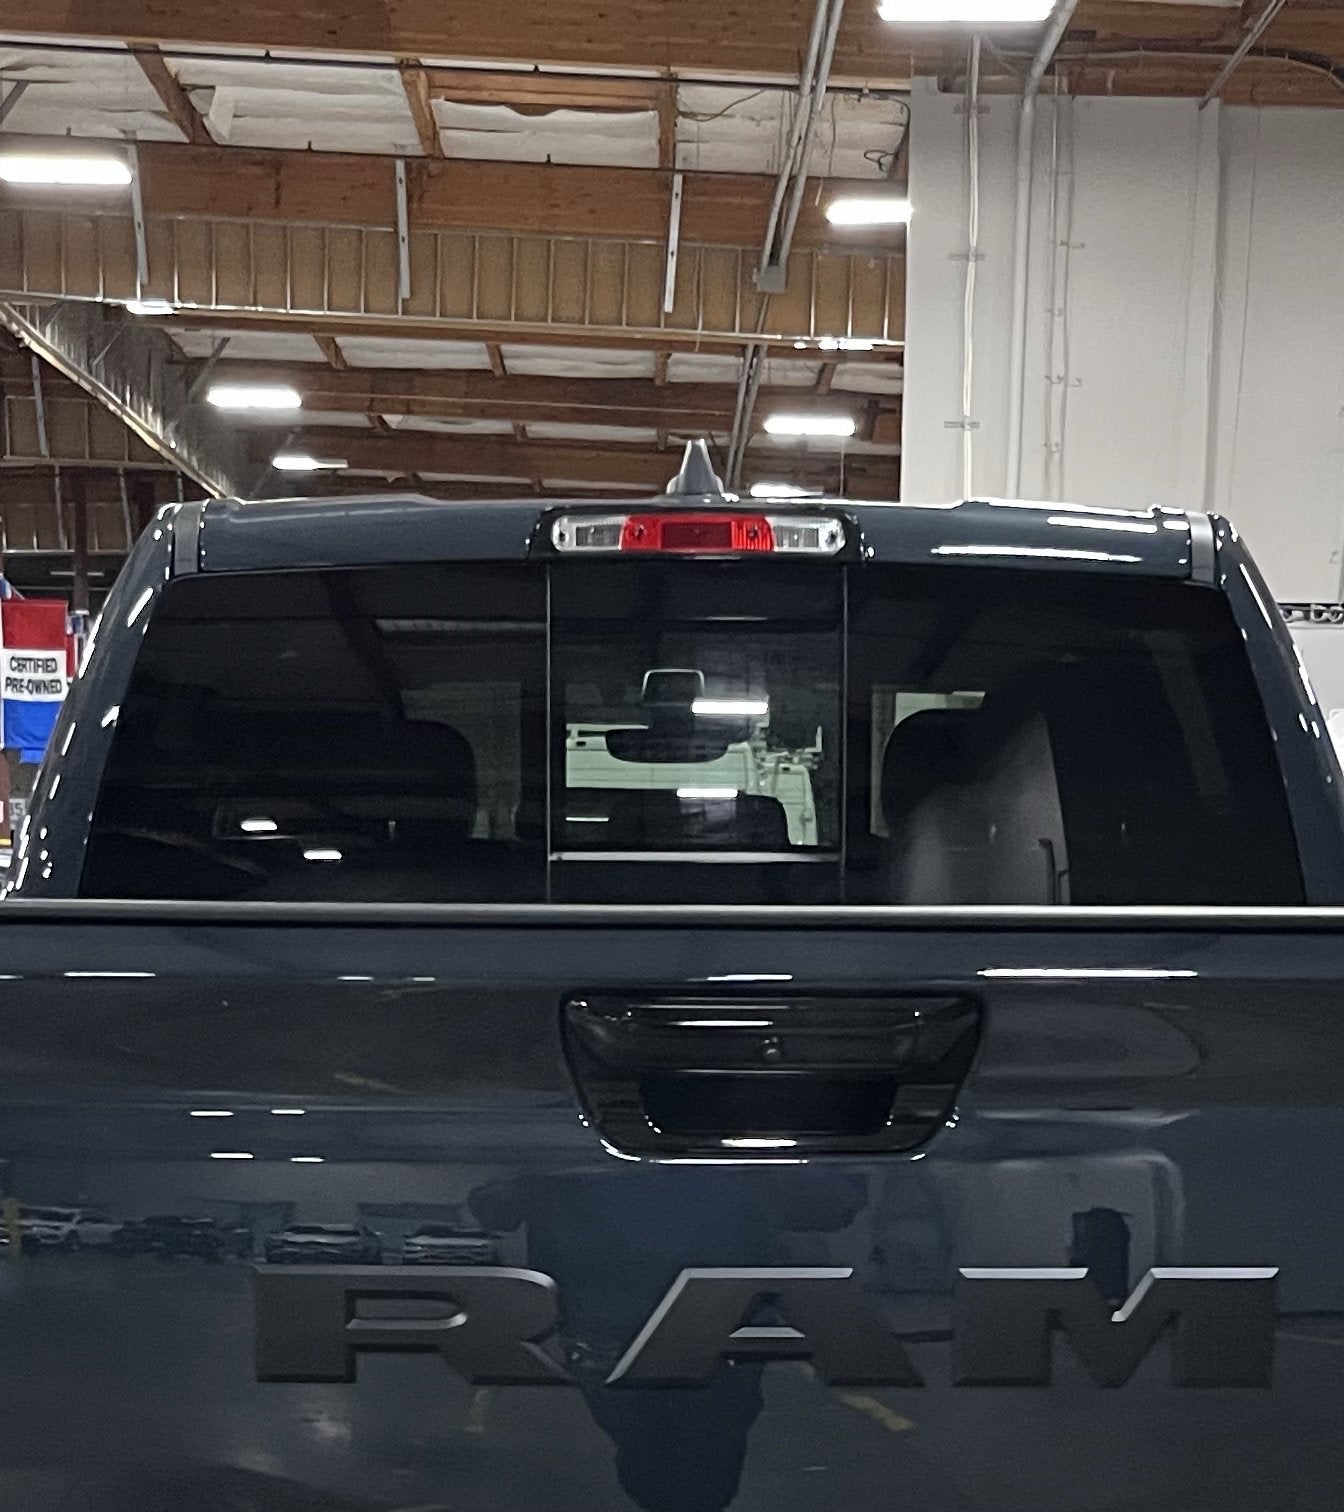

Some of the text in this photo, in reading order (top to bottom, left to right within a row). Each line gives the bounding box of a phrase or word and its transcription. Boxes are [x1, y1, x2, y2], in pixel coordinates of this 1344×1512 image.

[9, 656, 57, 674] CERTIFIED
[5, 678, 63, 695] PRE-OWNED
[256, 1265, 1278, 1388] RAM
